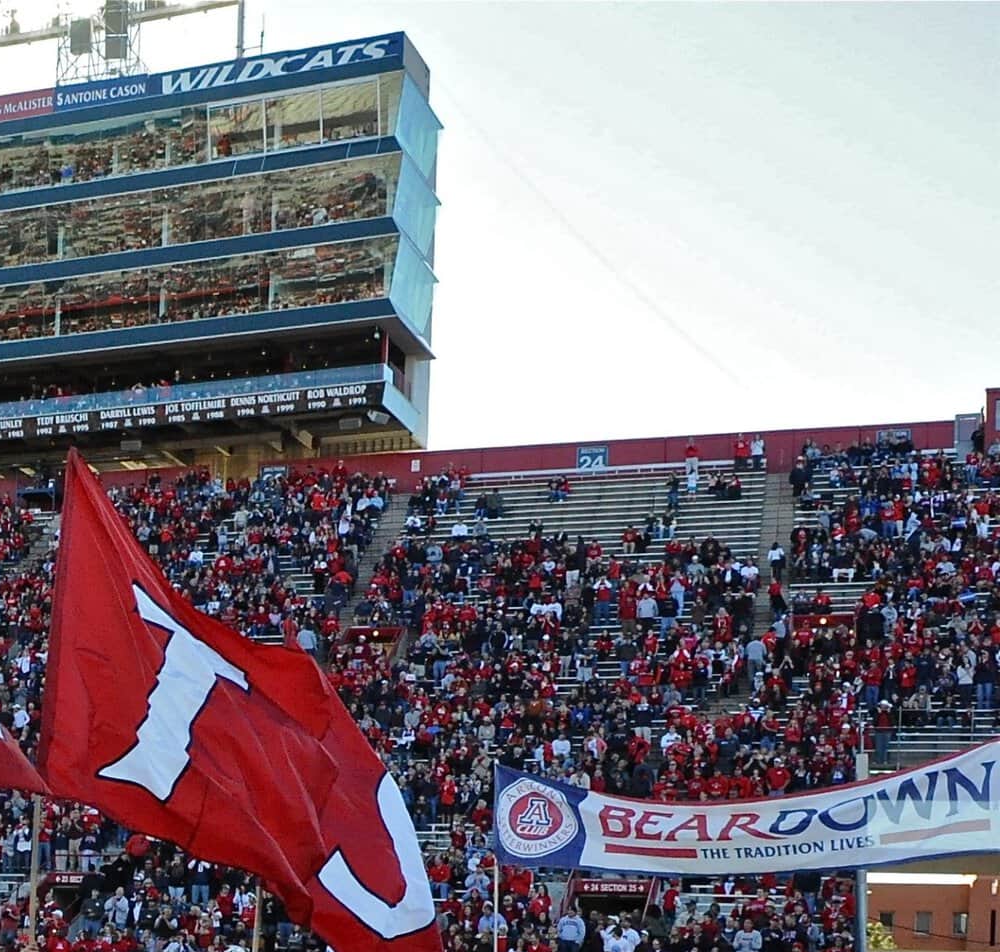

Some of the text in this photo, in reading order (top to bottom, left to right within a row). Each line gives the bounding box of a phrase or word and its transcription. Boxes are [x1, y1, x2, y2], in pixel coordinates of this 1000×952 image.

[161, 39, 392, 95] WILDCATS
[56, 82, 147, 107] 5 ANTOINE CASON
[3, 95, 53, 114] McALISTER
[230, 391, 300, 407] DENNIS NORTHCUTT
[307, 385, 367, 400] ROB WALDROP
[100, 406, 155, 420] DARRYLL LEWIS
[165, 404, 179, 415] JOE
[37, 413, 89, 426] TEDY BRUSCHI
[579, 455, 605, 472] 24
[700, 835, 875, 860] THE TRADITION LIVES
[600, 883, 628, 892] SECTION
